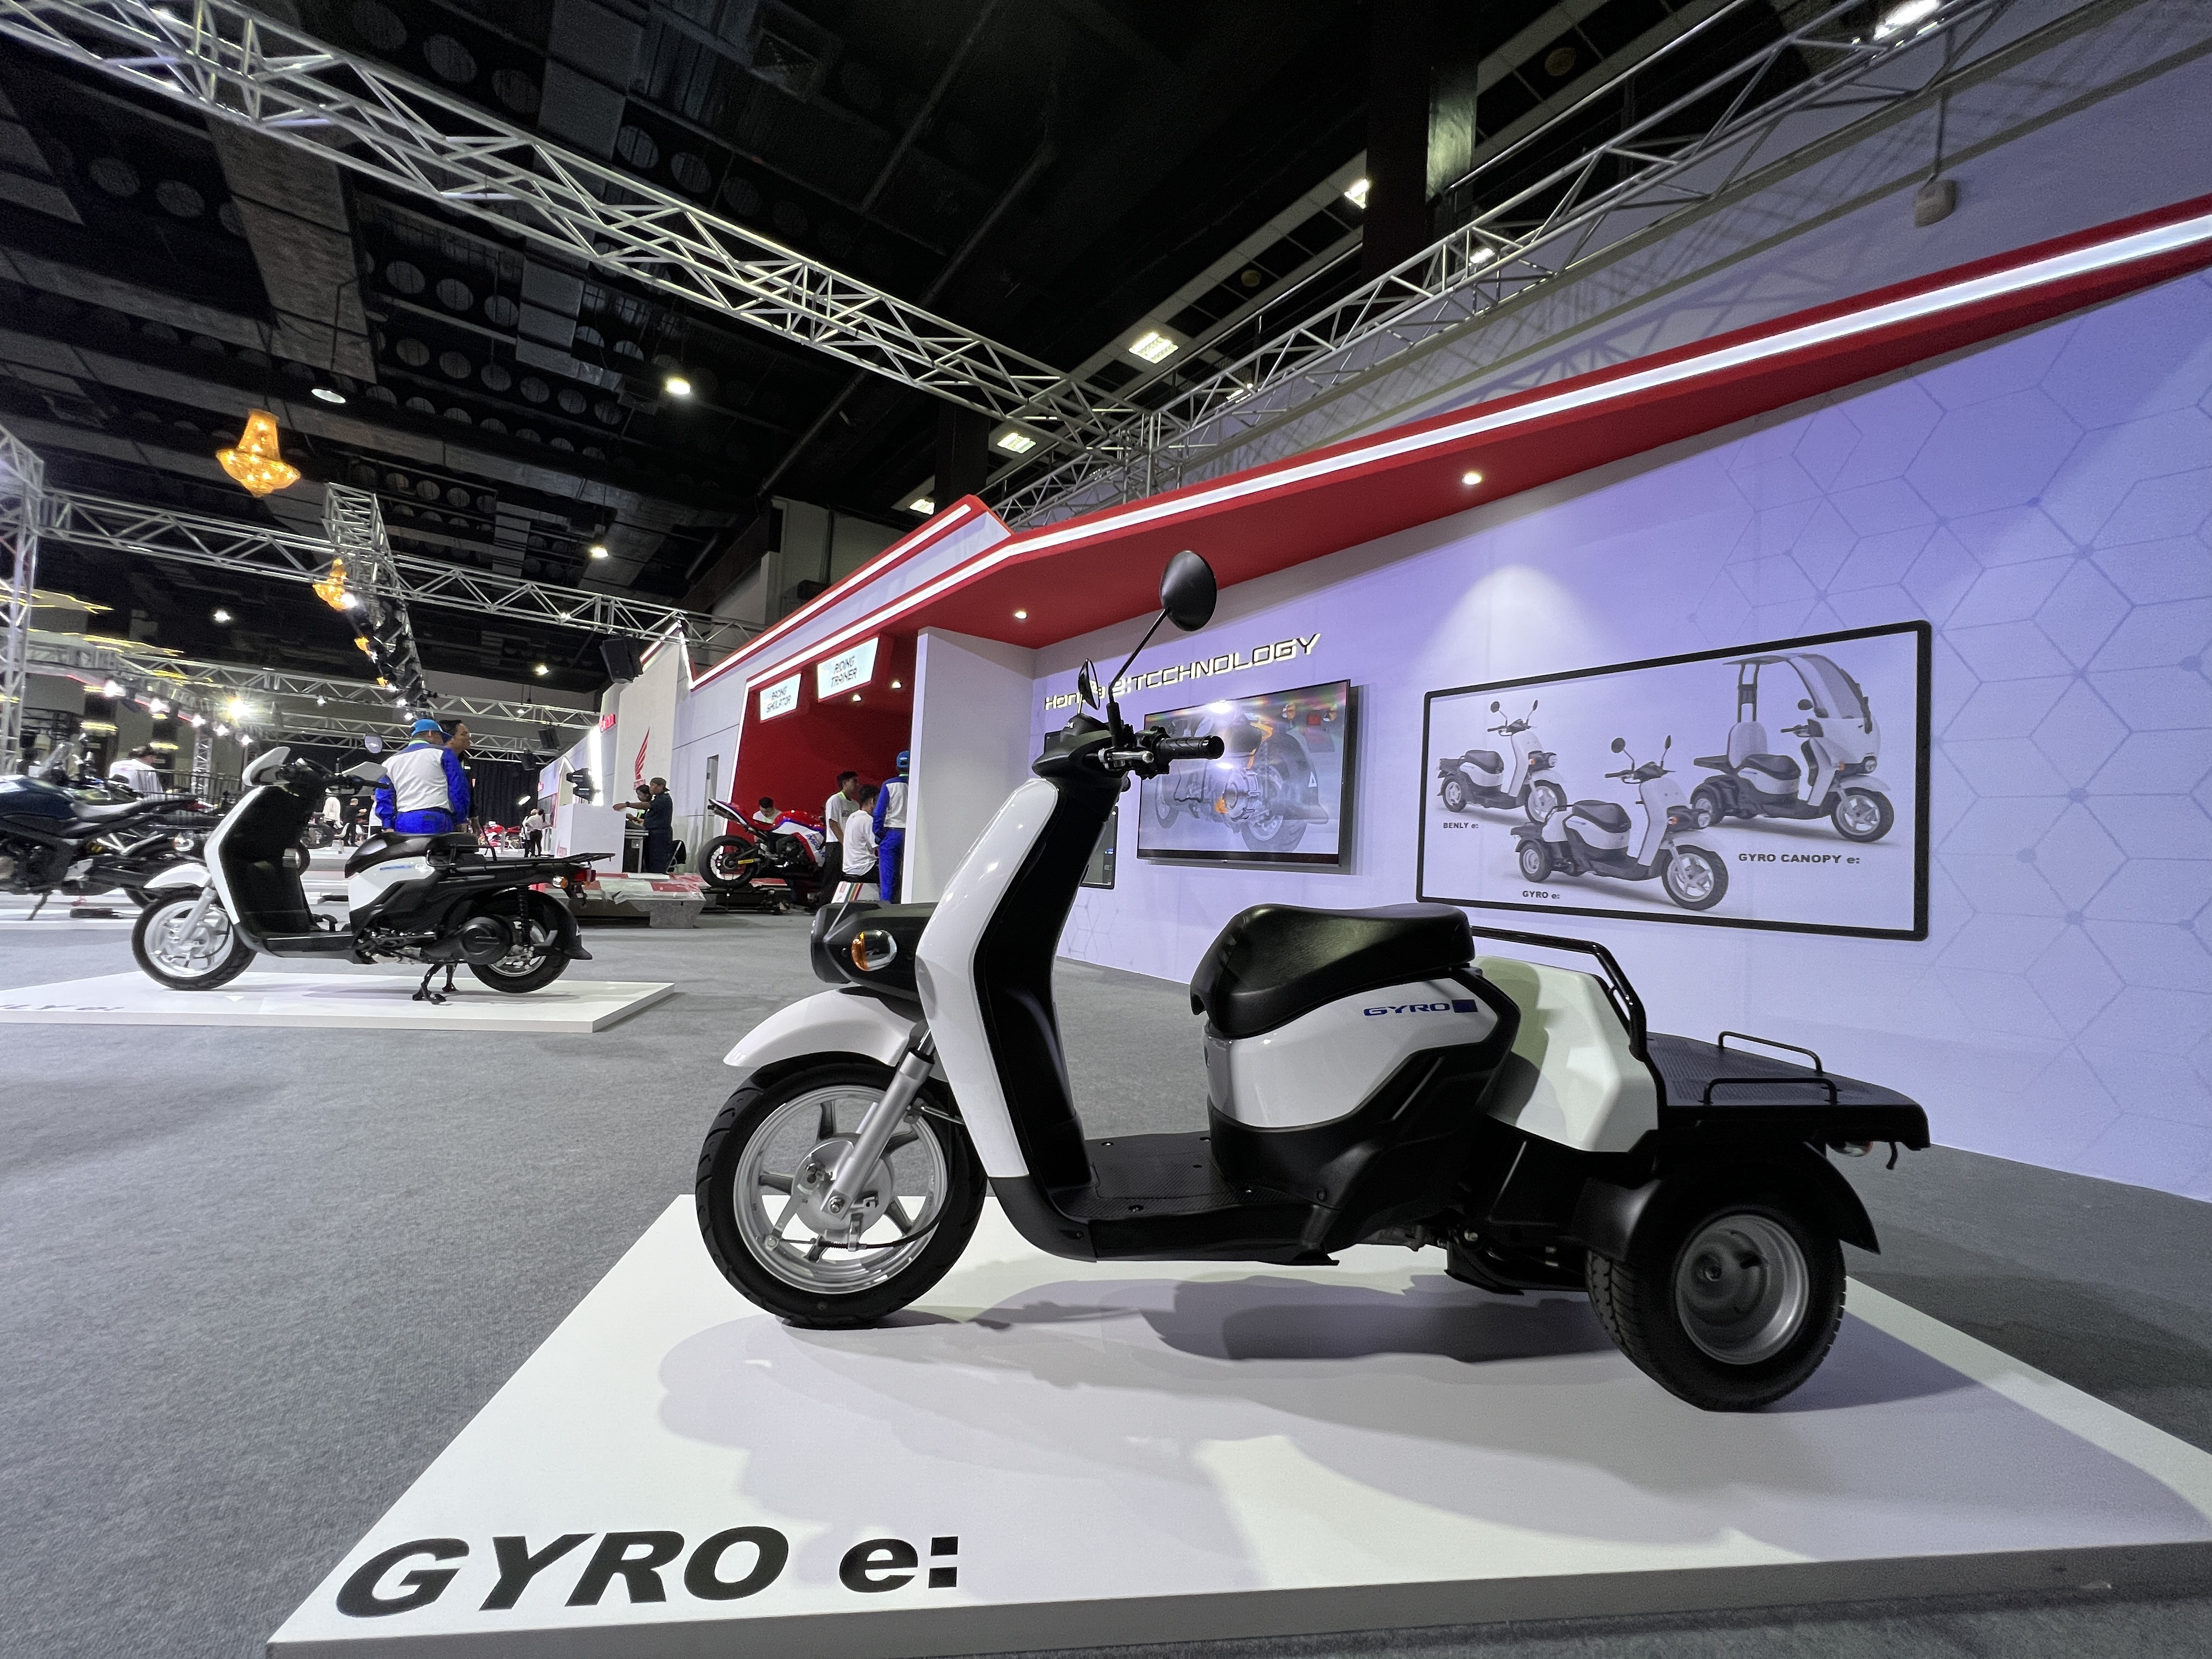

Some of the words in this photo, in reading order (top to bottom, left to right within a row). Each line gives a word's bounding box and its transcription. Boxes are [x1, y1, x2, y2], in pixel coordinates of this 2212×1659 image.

[1045, 685, 1106, 710] Hona
[1738, 853, 1776, 862] GYRO
[1781, 854, 1842, 864] CANOPY
[1522, 890, 1549, 899] GYRO
[1363, 1003, 1451, 1016] GYRO
[336, 1526, 789, 1618] GYRO
[838, 1536, 959, 1593] e:
